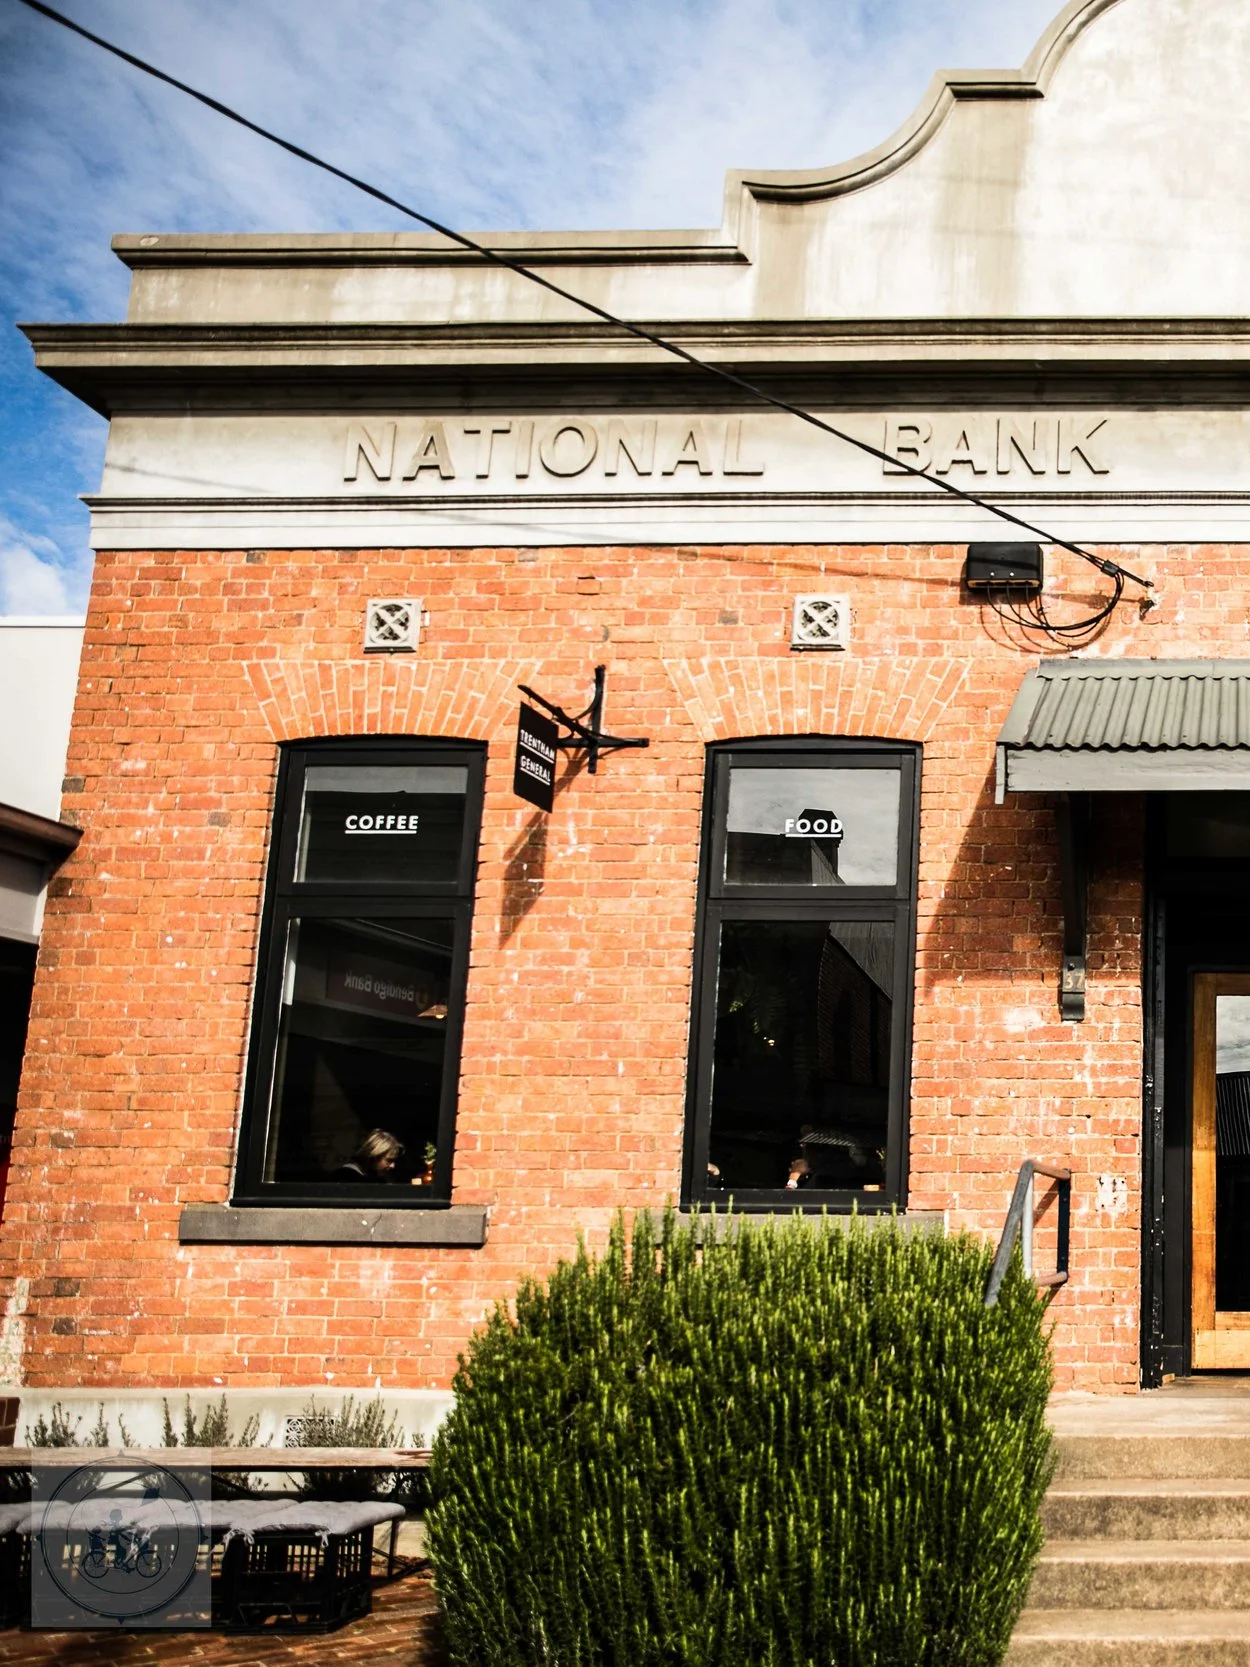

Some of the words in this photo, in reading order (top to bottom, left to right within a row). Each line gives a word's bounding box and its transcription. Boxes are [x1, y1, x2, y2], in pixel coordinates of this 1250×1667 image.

[343, 419, 766, 482] NATIONAL
[882, 418, 1111, 476] BANK
[520, 729, 555, 761] TRENTHAM
[520, 755, 551, 782] GENERAL
[345, 815, 419, 830] COFFEE
[785, 818, 843, 834] FOOD
[1064, 972, 1084, 989] 37
